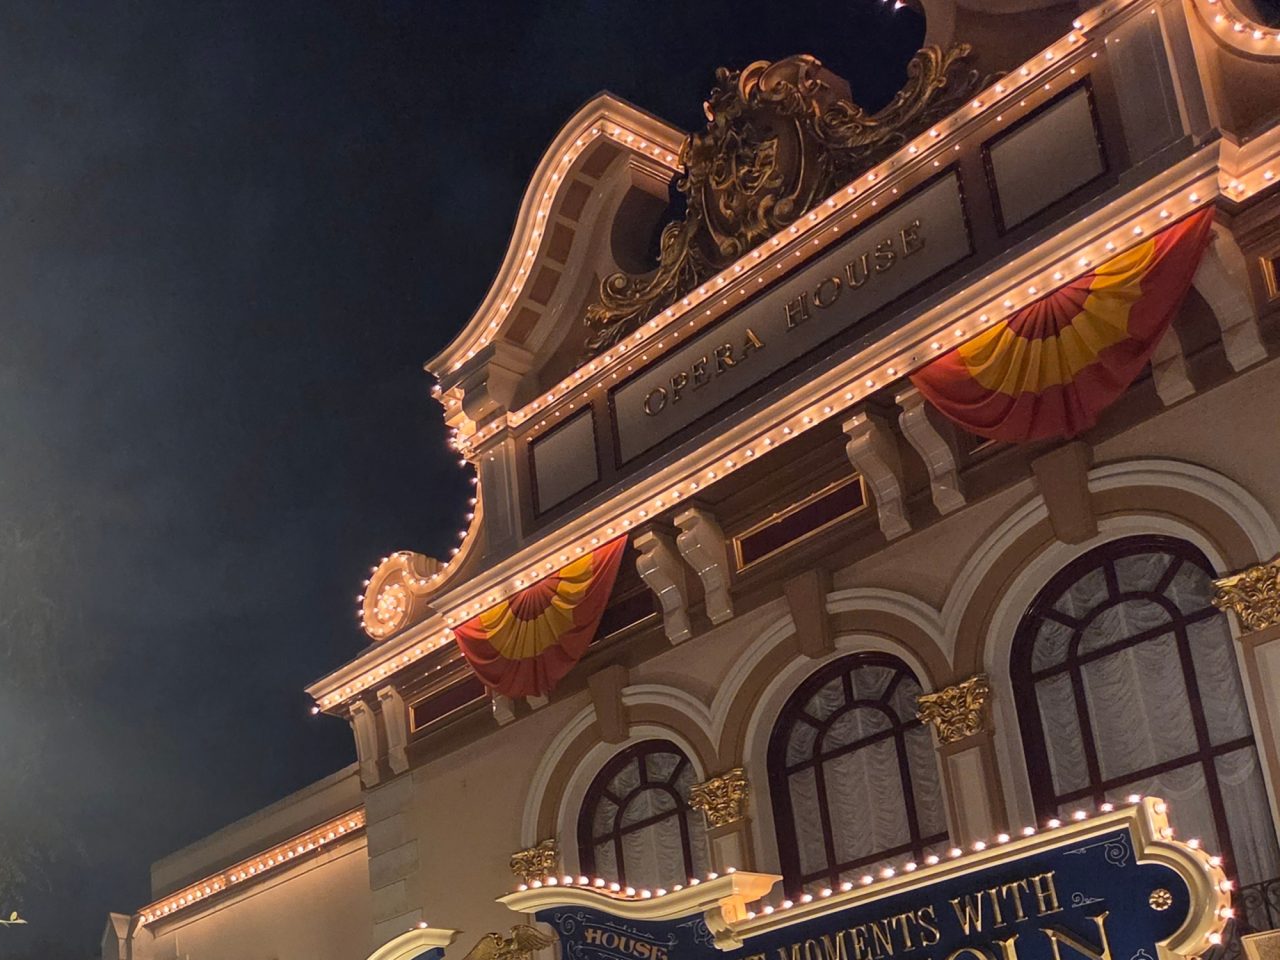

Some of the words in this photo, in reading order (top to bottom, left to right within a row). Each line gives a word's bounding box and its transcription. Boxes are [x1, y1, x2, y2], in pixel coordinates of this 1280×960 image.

[643, 327, 765, 418] OPERA
[783, 219, 928, 331] HOUSE
[951, 871, 1064, 936] WITH
